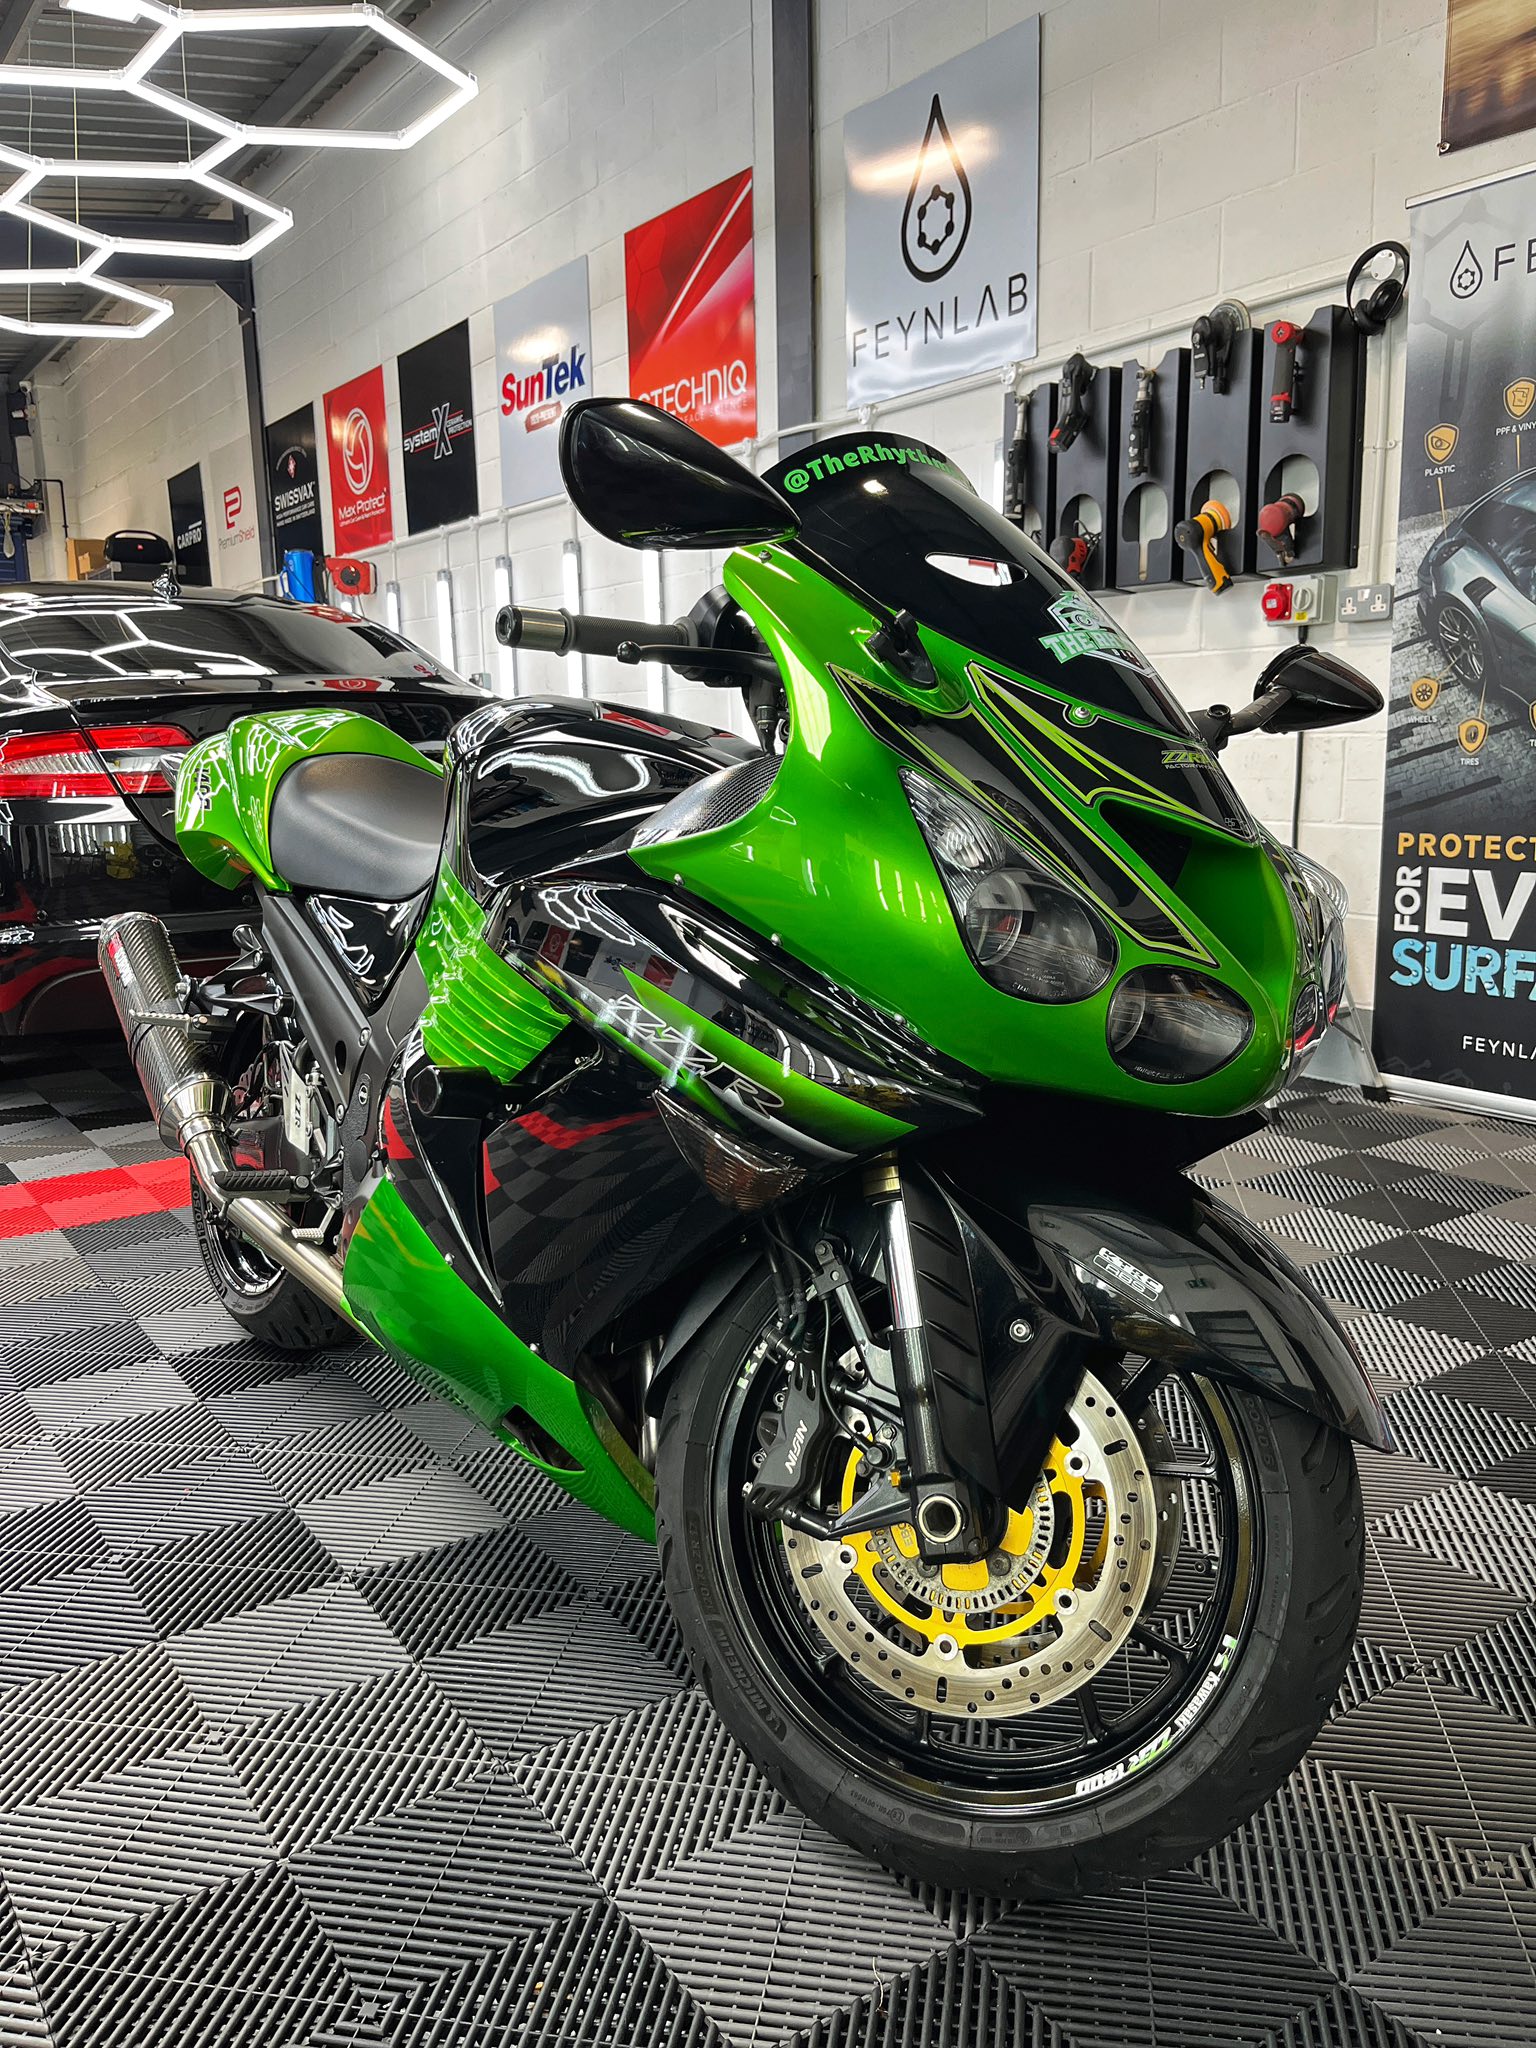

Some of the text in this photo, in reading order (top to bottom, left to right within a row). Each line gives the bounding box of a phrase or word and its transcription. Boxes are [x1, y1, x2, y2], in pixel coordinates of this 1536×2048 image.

[853, 272, 1028, 367] FEYNLAB
[501, 345, 586, 416] SunTek
[404, 427, 438, 453] system
[1495, 427, 1511, 436] PPF
[1511, 425, 1517, 433] &
[1424, 465, 1456, 477] PLASTIC
[274, 482, 315, 511] SWISSVAX
[177, 527, 203, 549] CARPRO
[1043, 631, 1094, 662] THE
[1407, 714, 1438, 723] WHEELS
[1460, 757, 1480, 766] TIRES
[1394, 865, 1422, 933] FOR
[1425, 867, 1536, 941] EV
[1389, 938, 1536, 1001] SURF
[1103, 1250, 1160, 1291] KTRC
[1106, 1263, 1146, 1293] ABS
[714, 1626, 769, 1712] MICHELIN
[1174, 1671, 1221, 1731] Kawasaki
